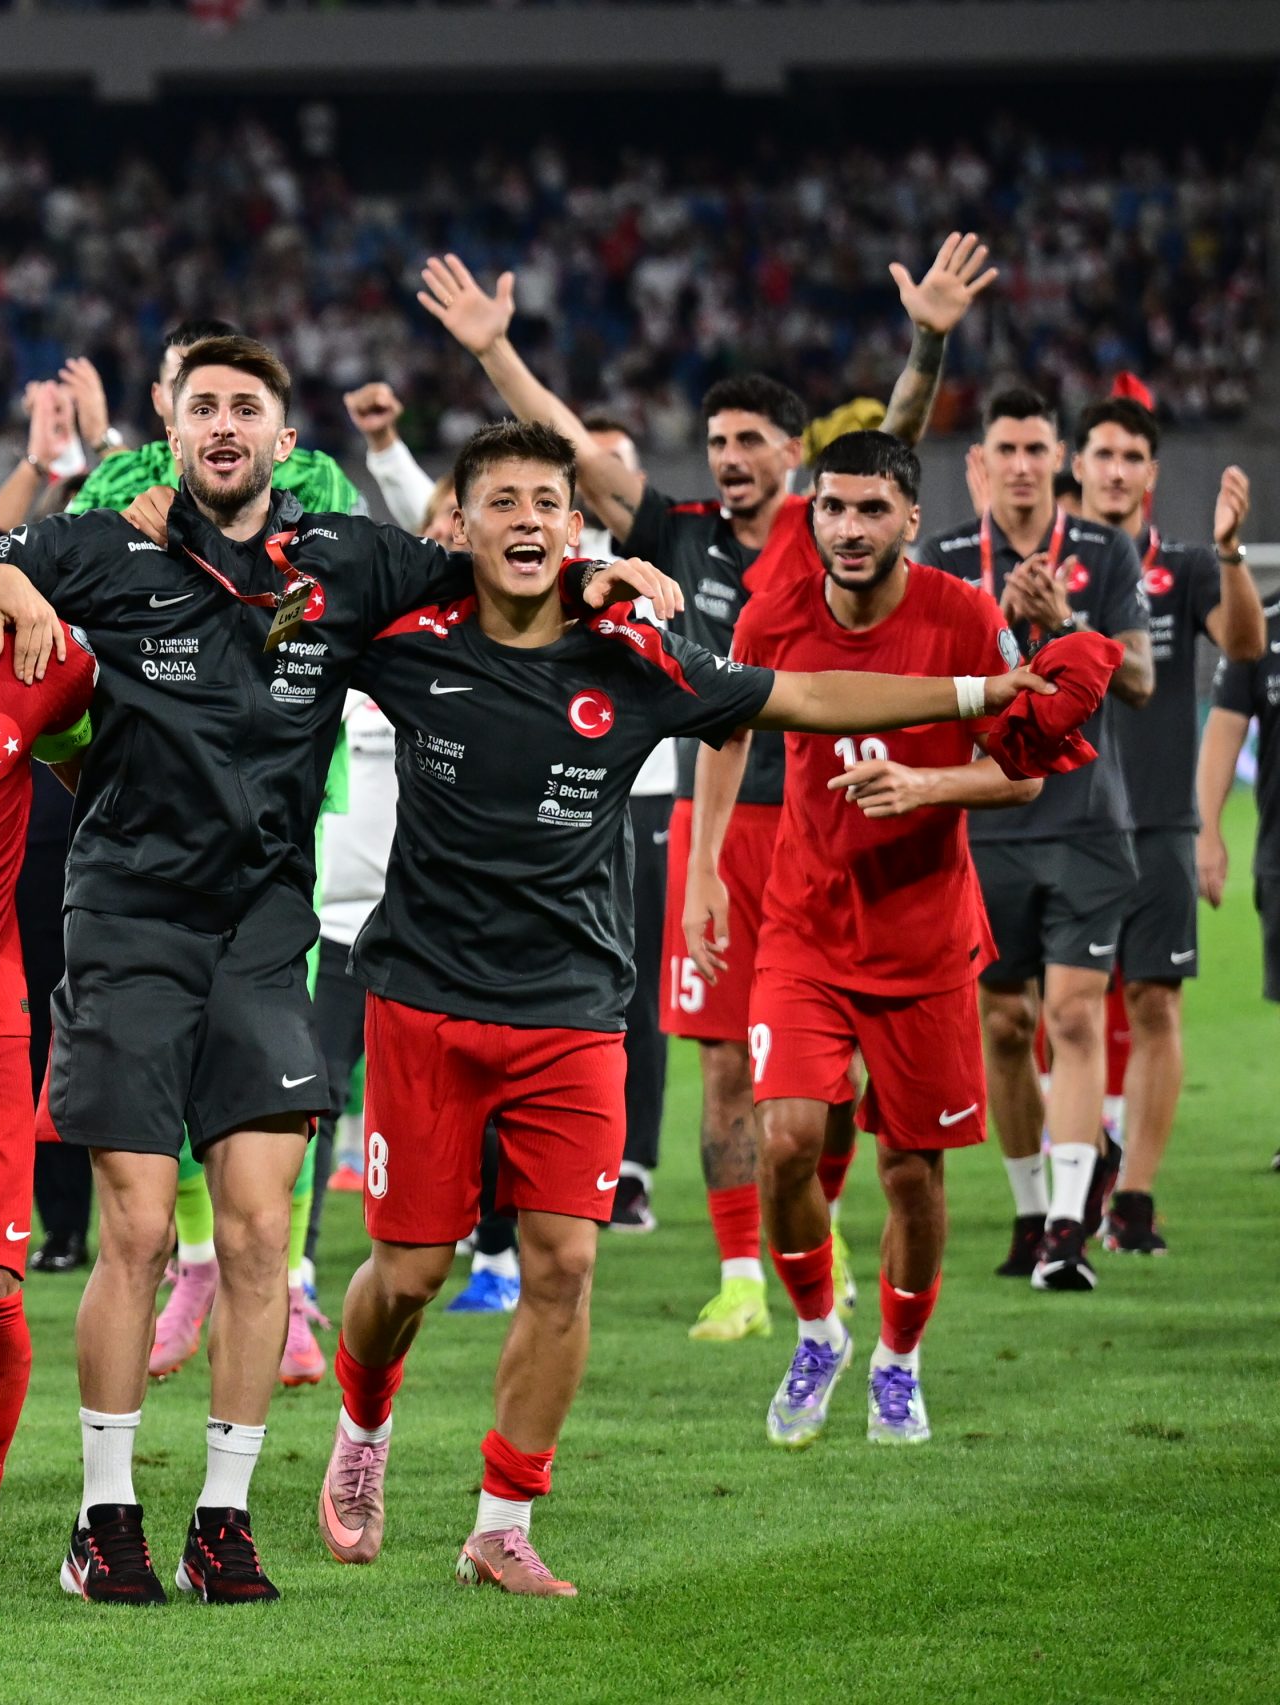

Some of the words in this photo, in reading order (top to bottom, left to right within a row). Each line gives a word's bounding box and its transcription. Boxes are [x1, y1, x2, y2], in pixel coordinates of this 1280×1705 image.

[301, 528, 339, 542] TURKCELL
[159, 638, 199, 647] TURKISH
[159, 646, 200, 654] AIRLINES
[288, 642, 329, 657] arçelik
[160, 661, 197, 674] NATA
[287, 662, 322, 675] BtcTurk
[159, 673, 197, 681] HOLDING
[426, 742, 464, 759] AIRLINES
[428, 735, 465, 751] TURKISH
[425, 756, 456, 777] NATA
[564, 766, 607, 782] arçelik
[559, 784, 599, 799] BtcTurk
[670, 955, 705, 1015] 15
[367, 1131, 389, 1200] 8
